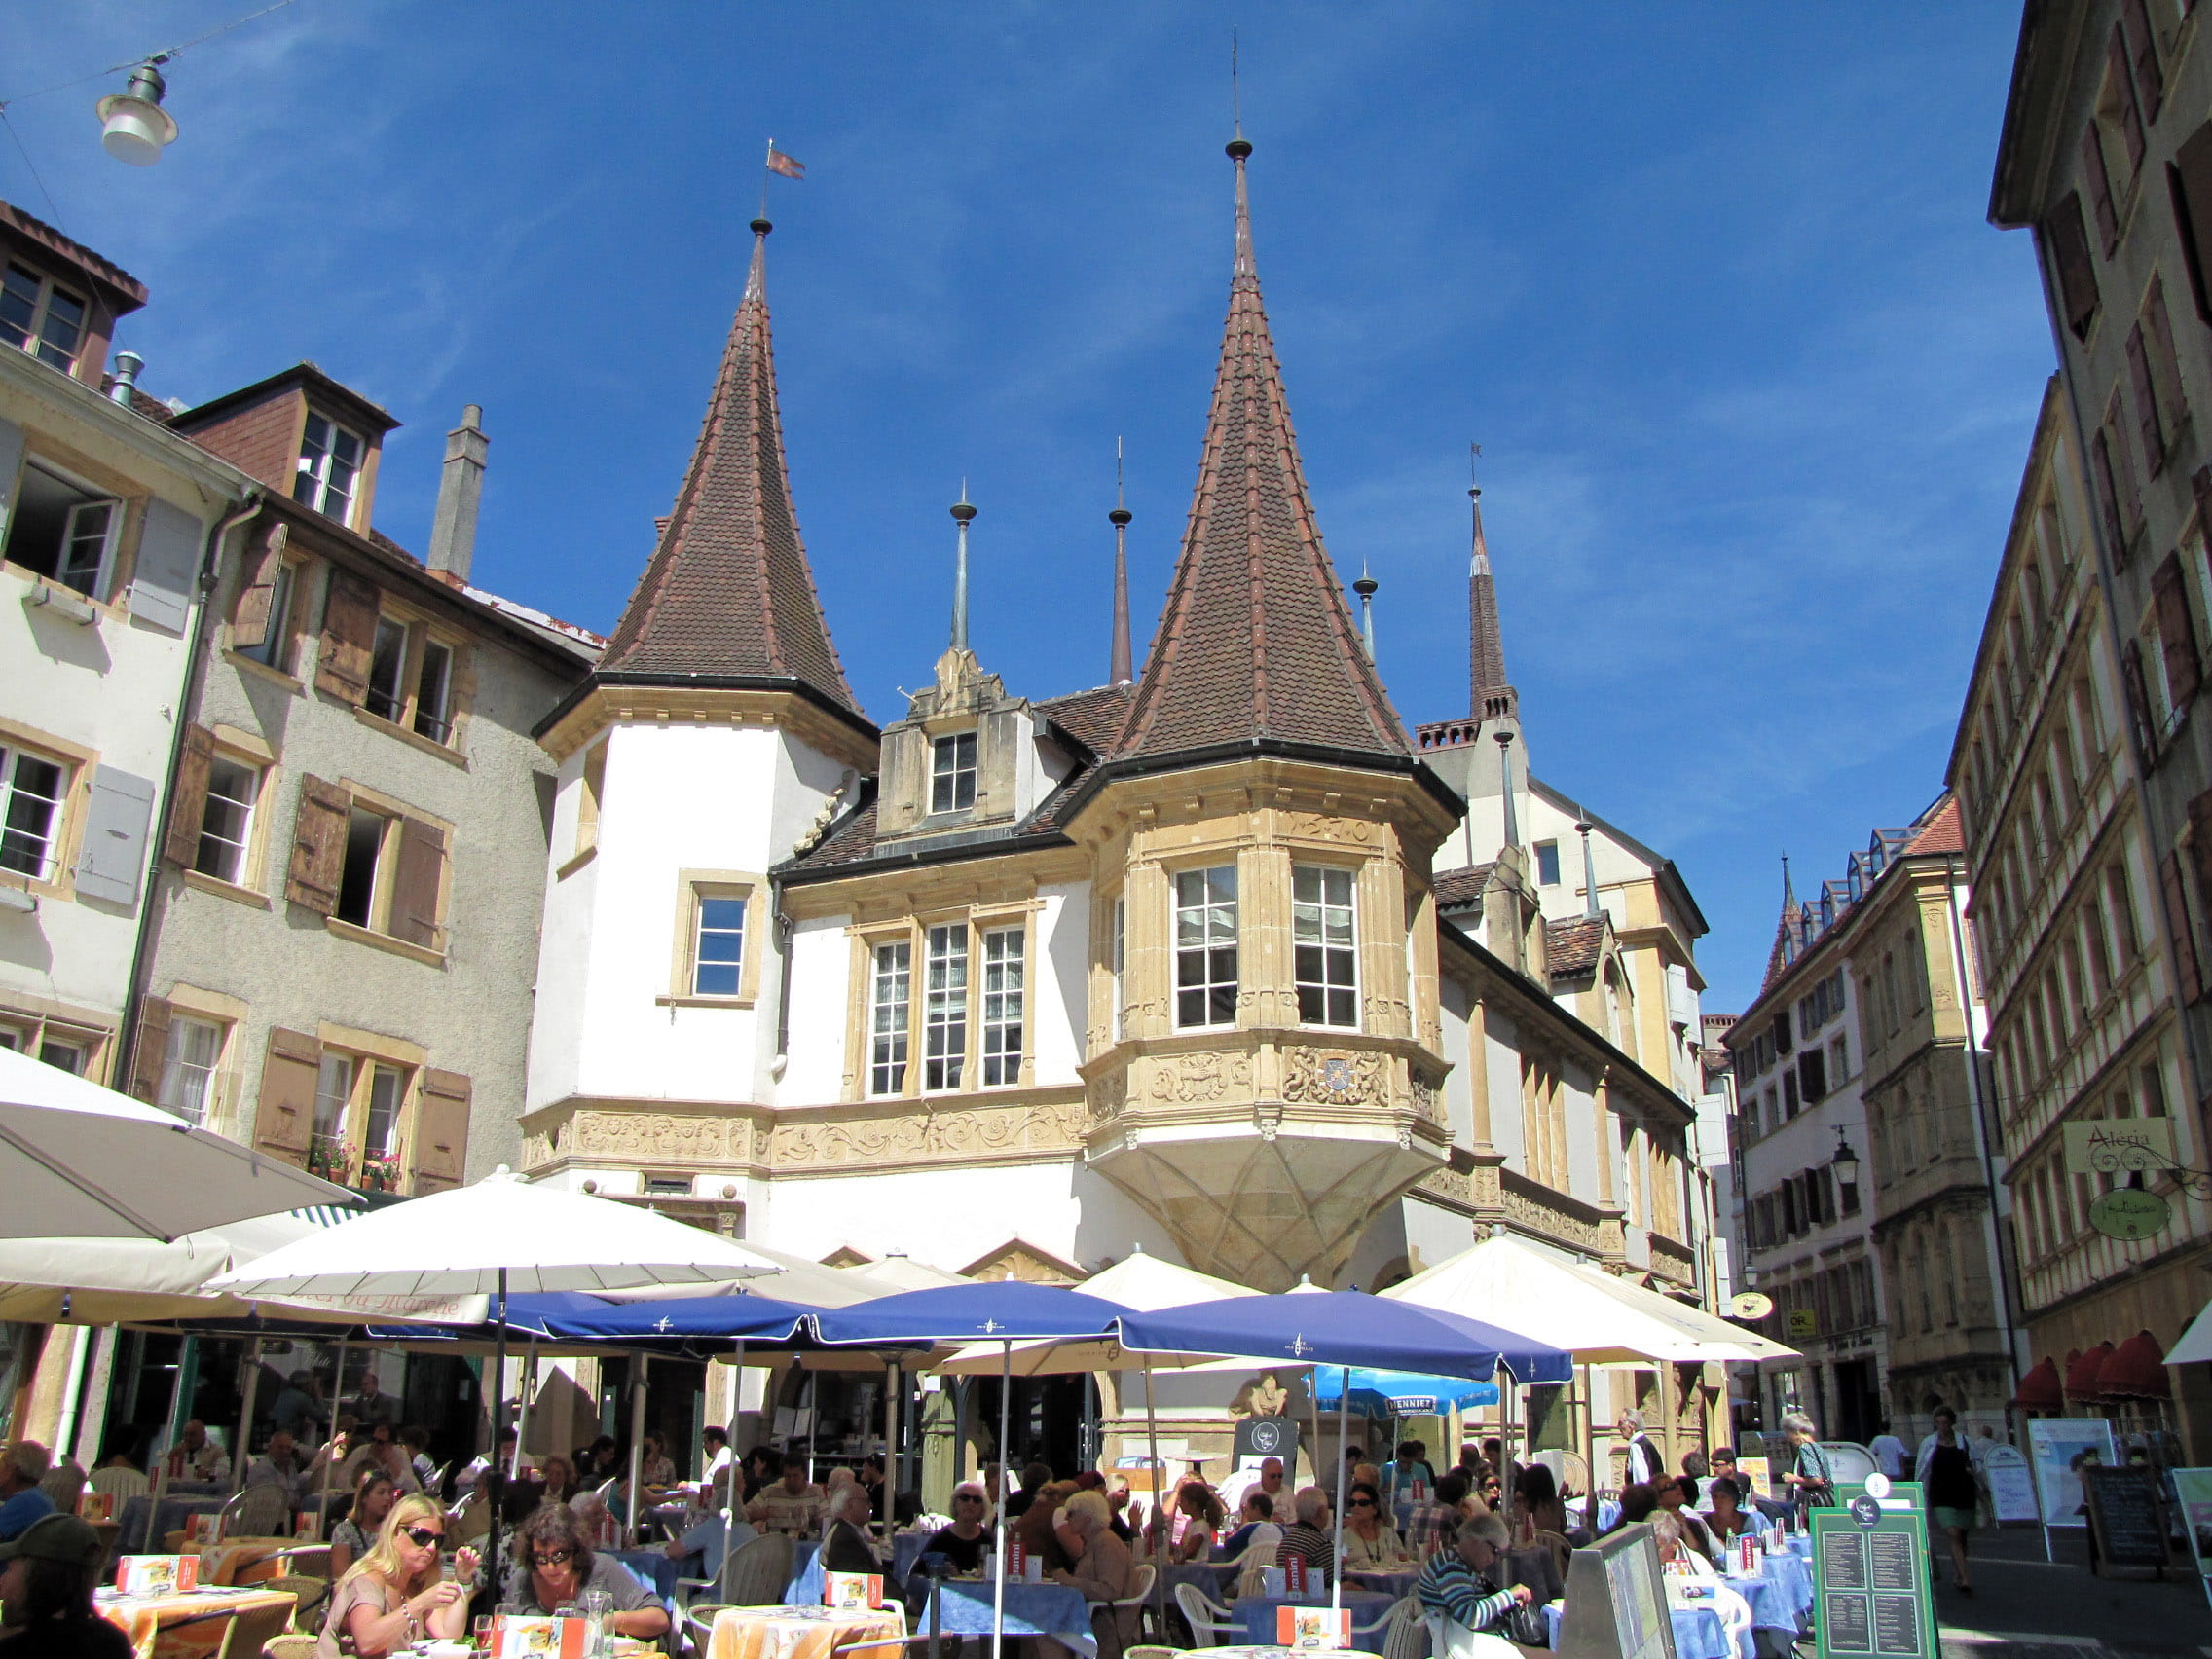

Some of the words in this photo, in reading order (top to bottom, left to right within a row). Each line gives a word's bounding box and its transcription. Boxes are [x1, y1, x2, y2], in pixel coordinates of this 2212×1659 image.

[2087, 1125, 2150, 1150] Aléria
[1389, 1399, 1431, 1409] HENNIEZ
[1289, 1557, 1300, 1590] ranini
